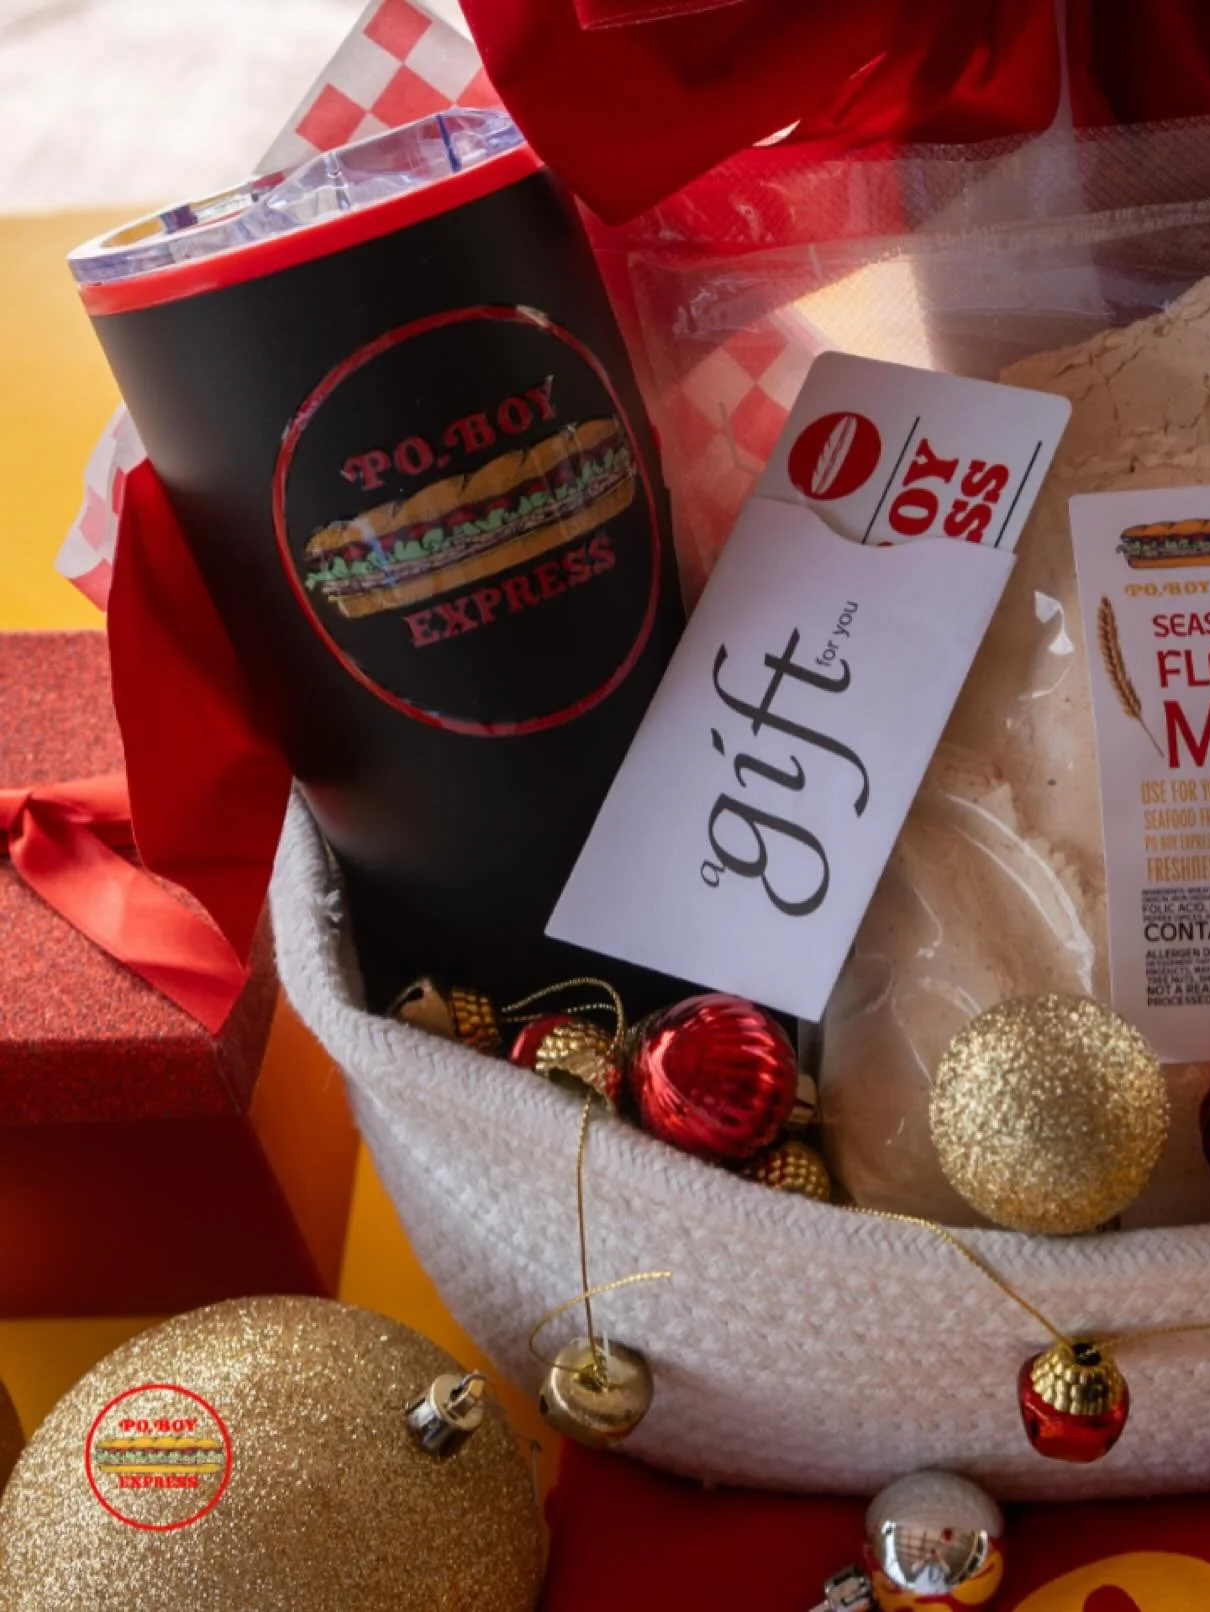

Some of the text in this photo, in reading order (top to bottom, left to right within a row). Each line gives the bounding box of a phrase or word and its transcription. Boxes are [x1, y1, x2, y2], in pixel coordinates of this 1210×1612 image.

[402, 532, 618, 649] EXPRESS
[813, 600, 860, 668] for you
[699, 626, 871, 919] a gift
[1141, 778, 1167, 804] USE
[1171, 779, 1198, 803] FOR
[1144, 806, 1196, 830] SEAFOOD
[1143, 902, 1176, 914] FOLIC
[1146, 947, 1201, 959] ALLERGEN
[1148, 983, 1170, 995] NOT
